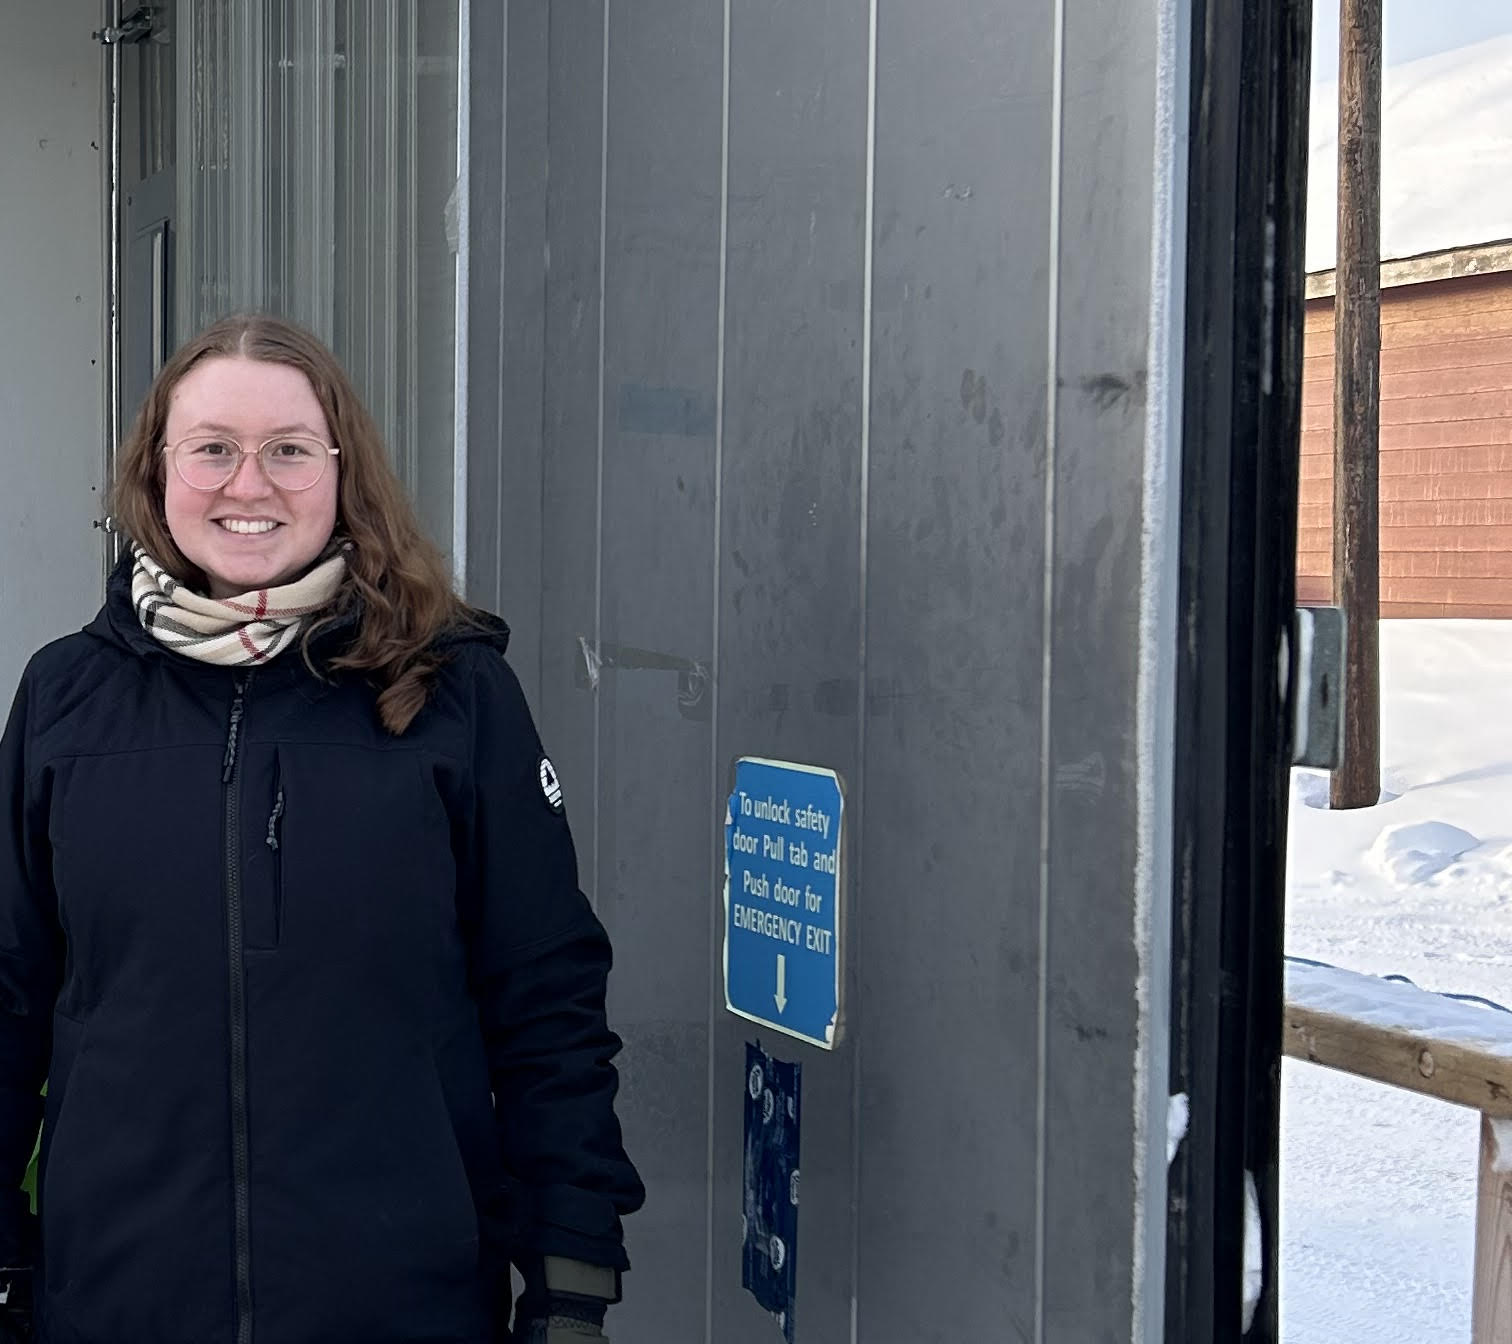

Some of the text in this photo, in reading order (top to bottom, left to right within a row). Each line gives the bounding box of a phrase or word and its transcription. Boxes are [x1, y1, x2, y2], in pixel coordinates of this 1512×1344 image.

[739, 791, 830, 840] To unlock safety
[733, 827, 836, 875] door Pull tab and
[743, 870, 822, 913] Push door for
[734, 903, 832, 955] EMERGENCY EXIT
